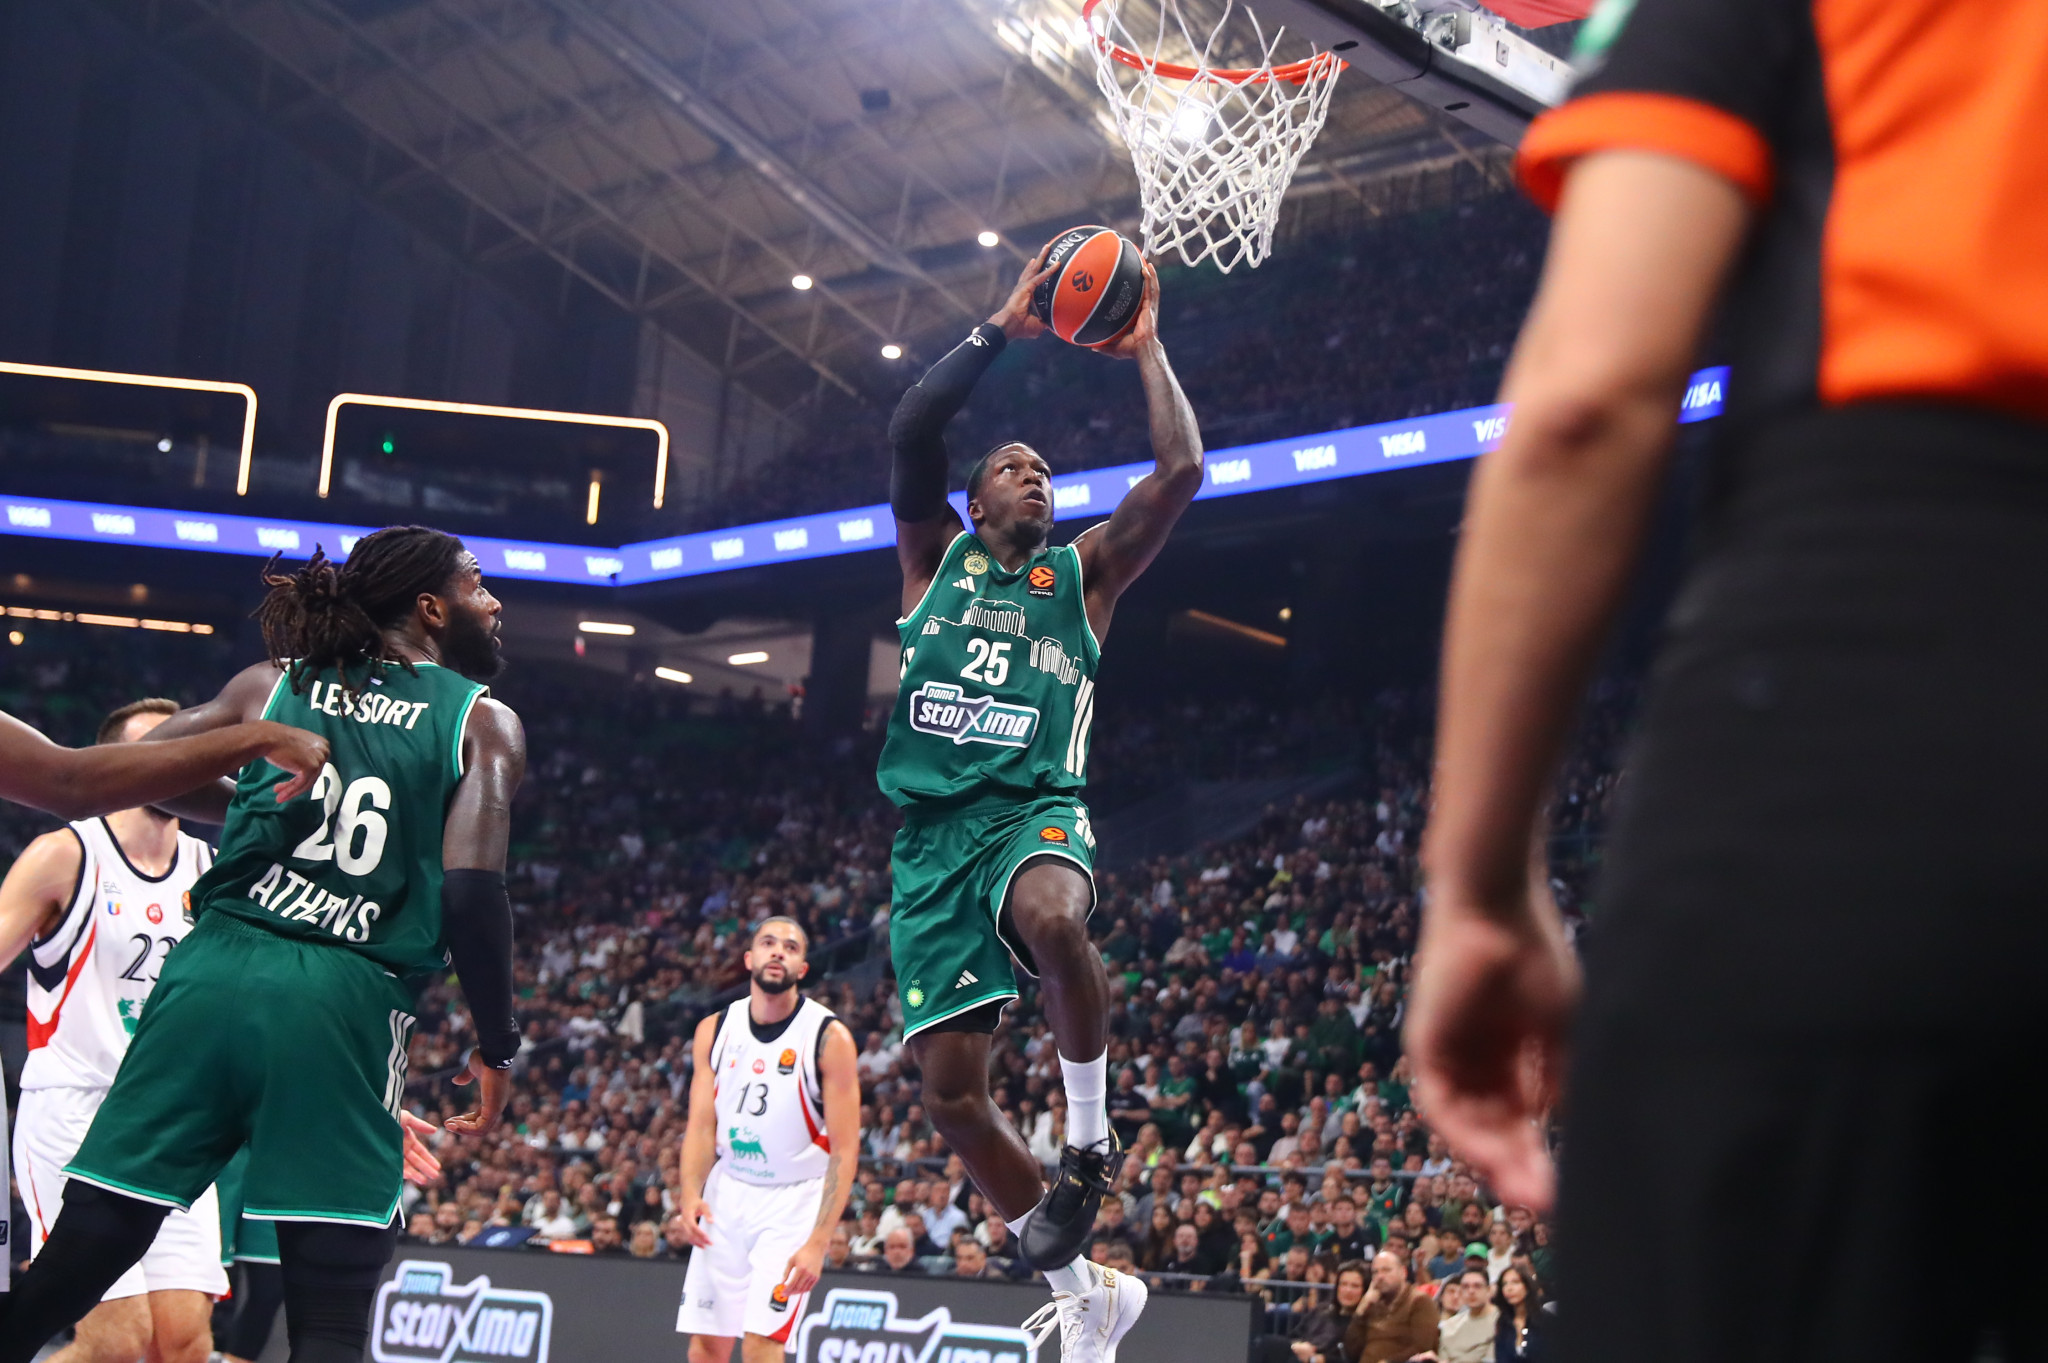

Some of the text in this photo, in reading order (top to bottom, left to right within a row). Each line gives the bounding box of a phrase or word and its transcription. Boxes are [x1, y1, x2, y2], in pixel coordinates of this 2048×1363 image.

[1208, 458, 1252, 485] VISA
[1292, 444, 1337, 472] VISA
[1379, 430, 1426, 458] VISA
[1472, 416, 1506, 442] VIS
[960, 637, 1011, 686] 25
[310, 680, 429, 730] LESSORT
[927, 688, 956, 700] pame
[292, 762, 392, 876] 26
[248, 862, 381, 943] ATHENS
[735, 1081, 769, 1116] 13
[830, 1303, 885, 1331] pame
